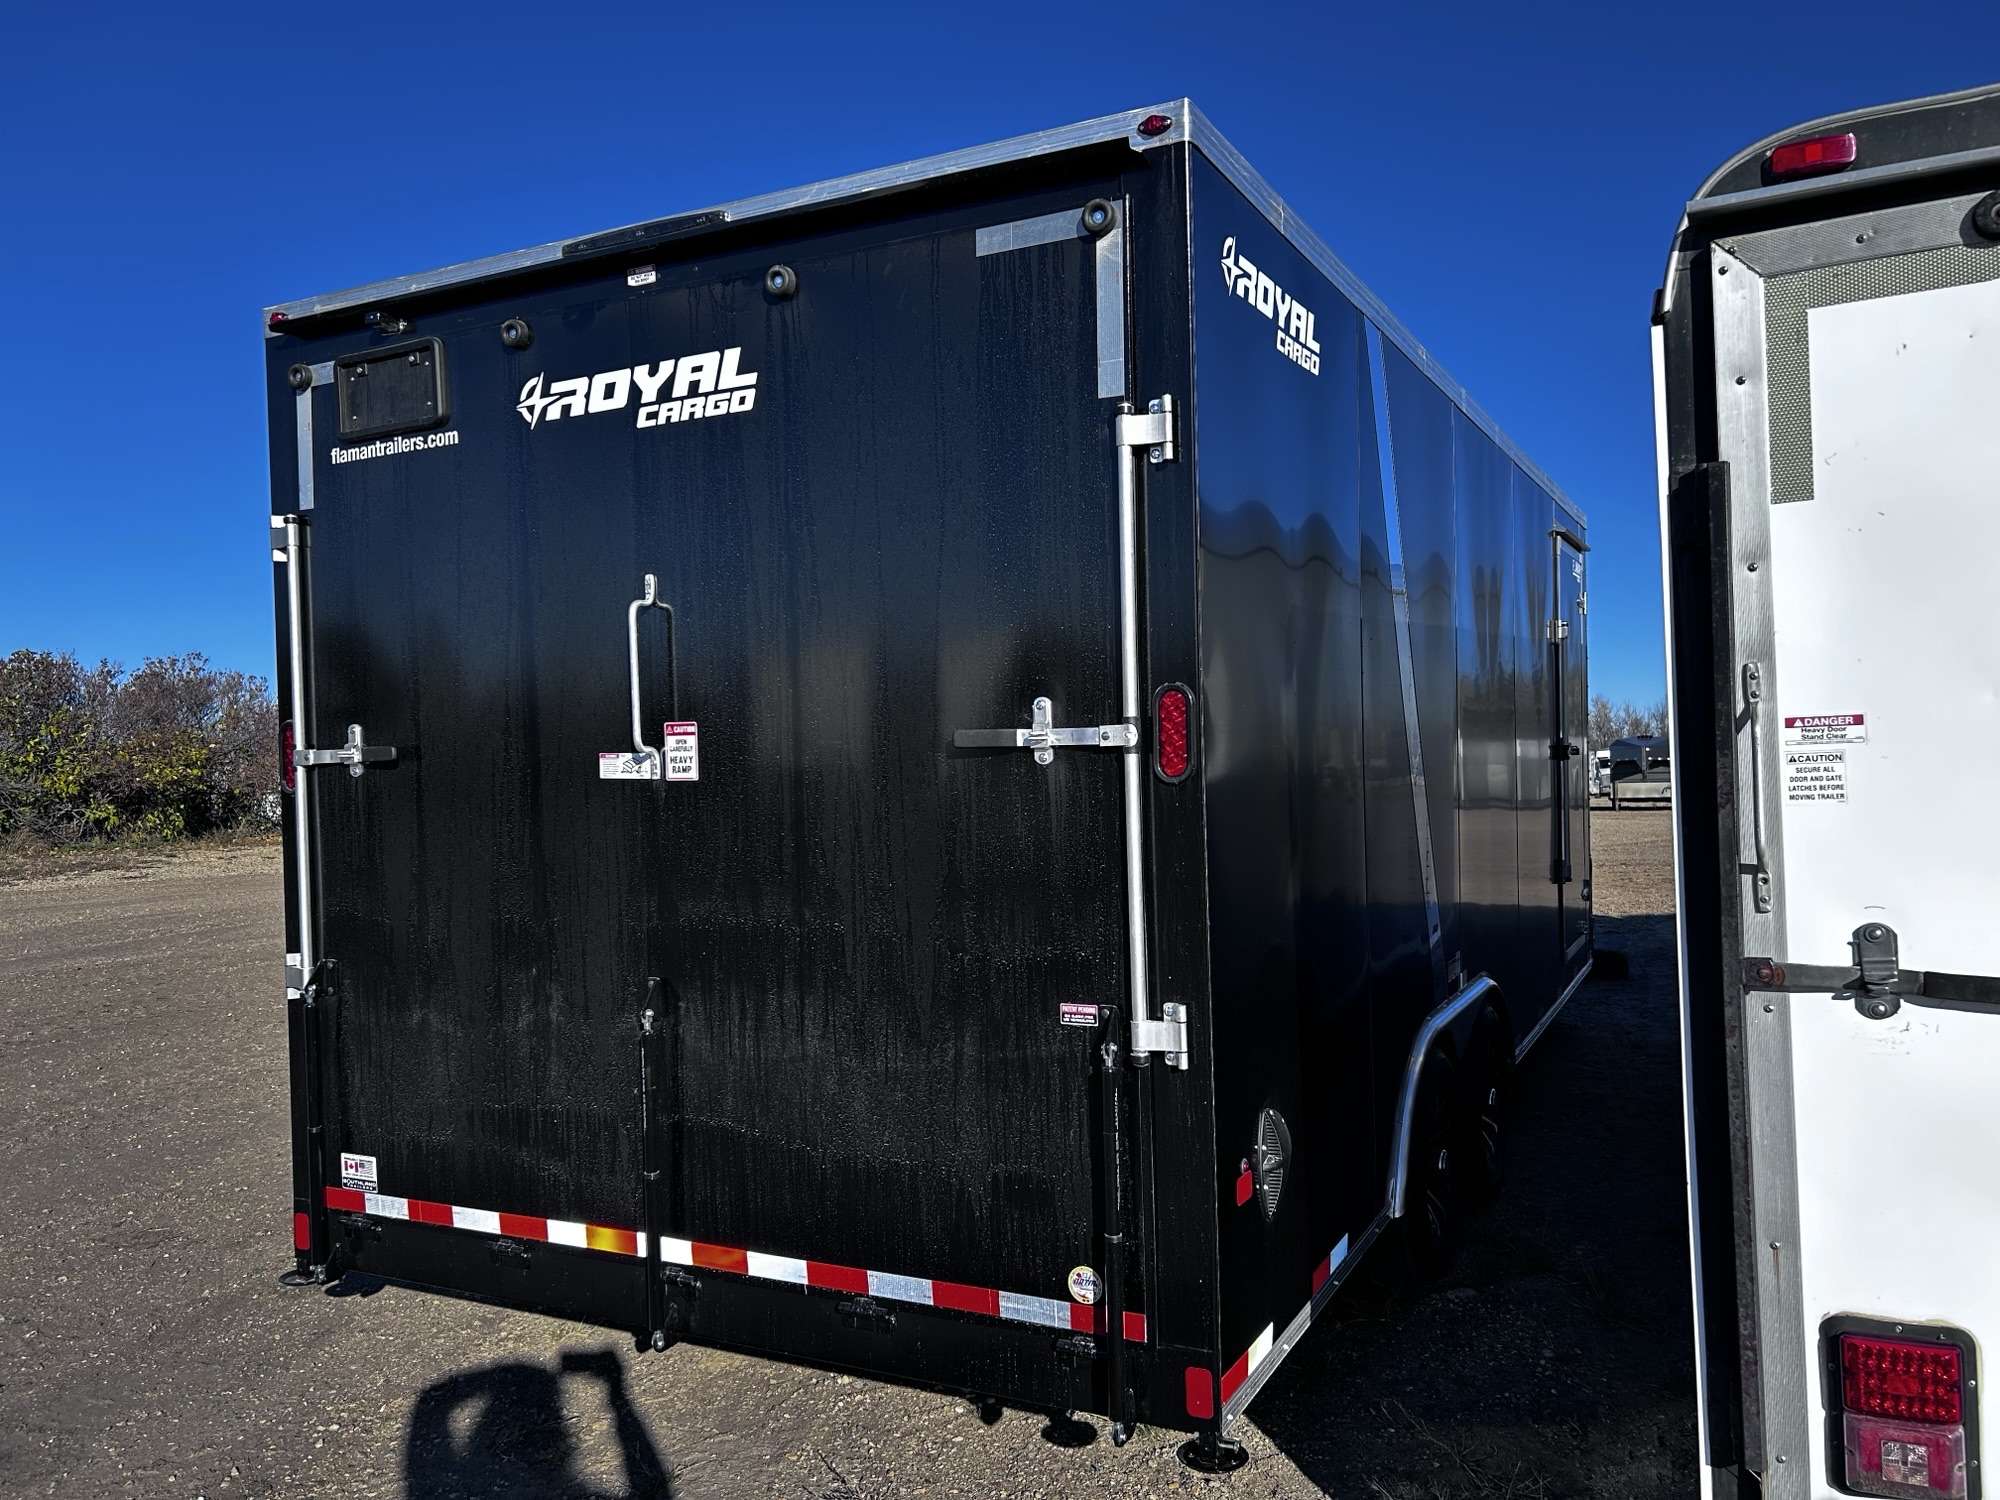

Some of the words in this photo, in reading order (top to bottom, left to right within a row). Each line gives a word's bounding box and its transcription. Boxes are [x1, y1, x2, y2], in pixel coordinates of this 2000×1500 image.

[1236, 254, 1321, 354] ROYAL
[1276, 329, 1321, 376] CARGO
[544, 346, 759, 422] ROYAL
[635, 388, 757, 429] CARGO
[331, 430, 460, 465] flamantrailers.com
[1804, 716, 1854, 726] DANGER
[669, 755, 694, 765] HEAVY
[672, 765, 692, 774] RAMP
[1797, 754, 1842, 763] CAUTION
